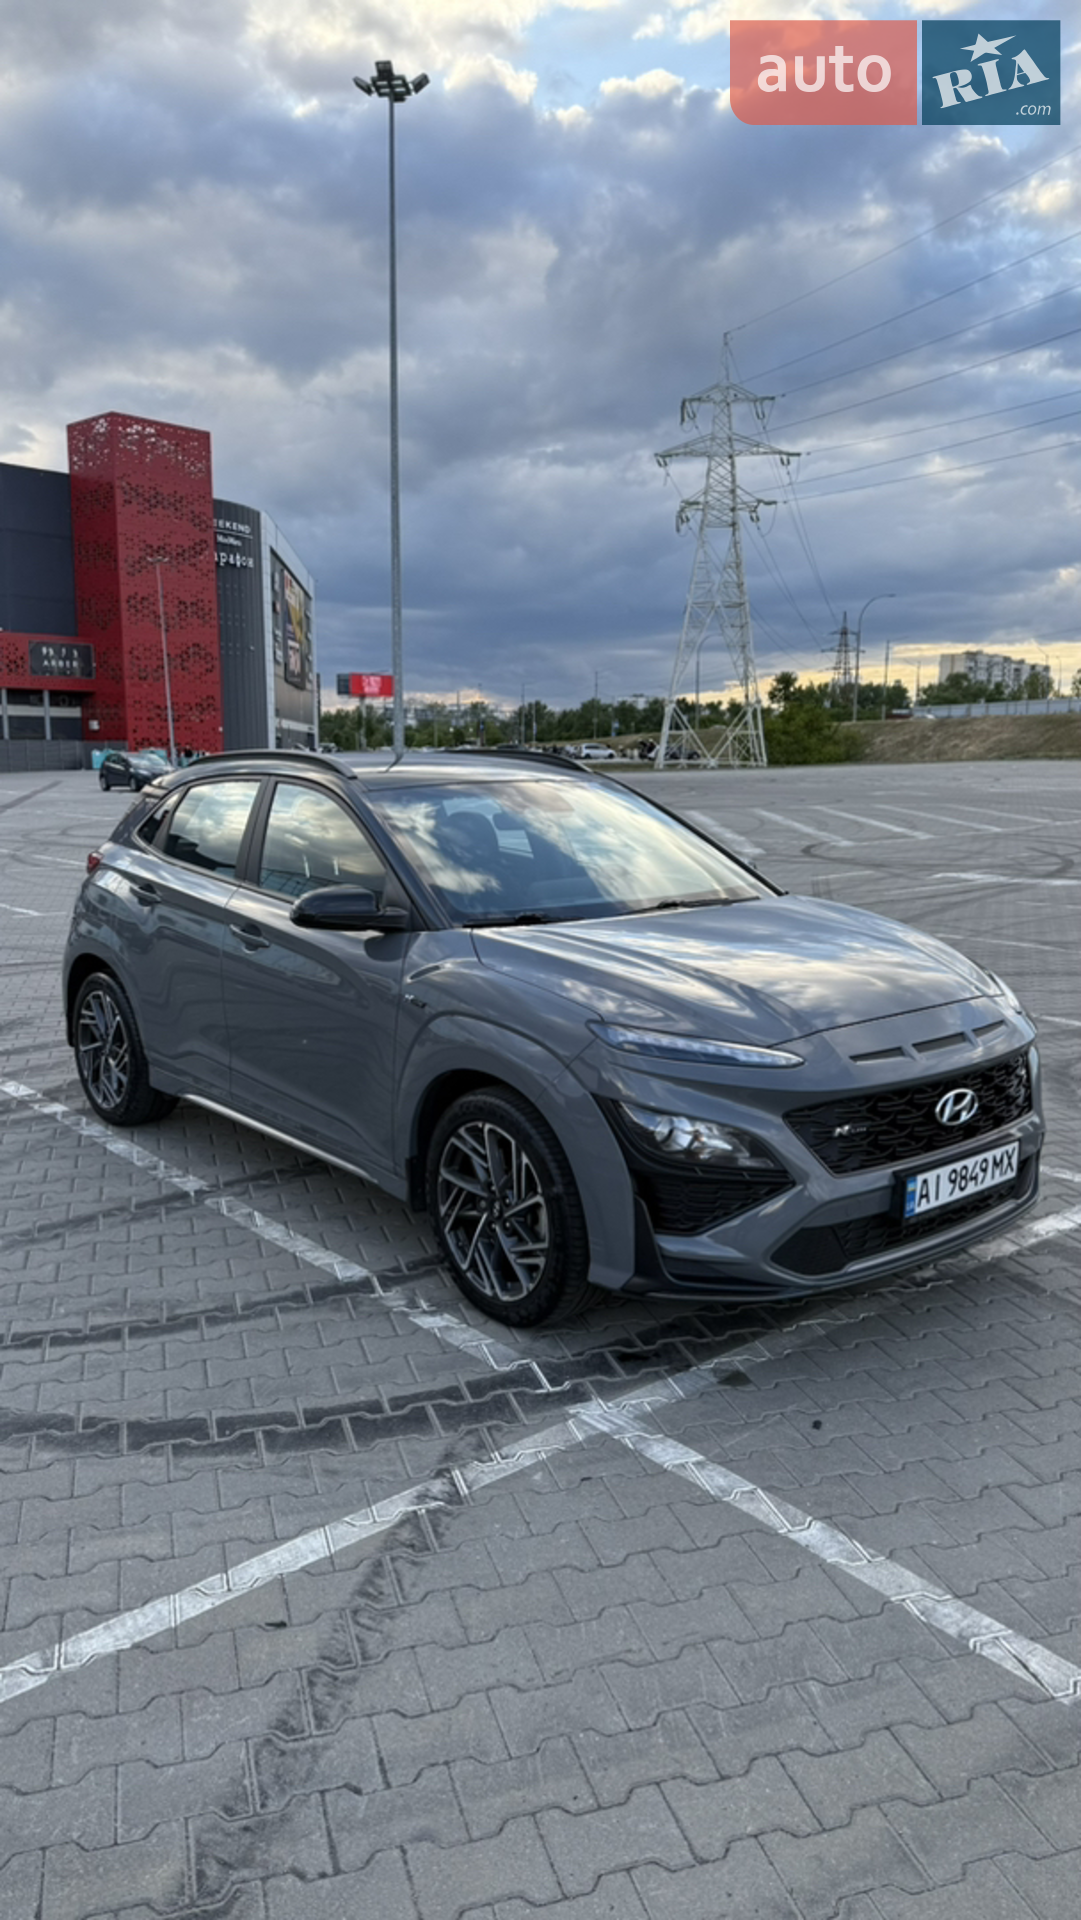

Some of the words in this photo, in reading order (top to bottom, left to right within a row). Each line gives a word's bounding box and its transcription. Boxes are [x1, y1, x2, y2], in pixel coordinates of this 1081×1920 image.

[917, 1174, 940, 1207] AI
[948, 1157, 989, 1197] 9849
[991, 1146, 1016, 1181] MX
